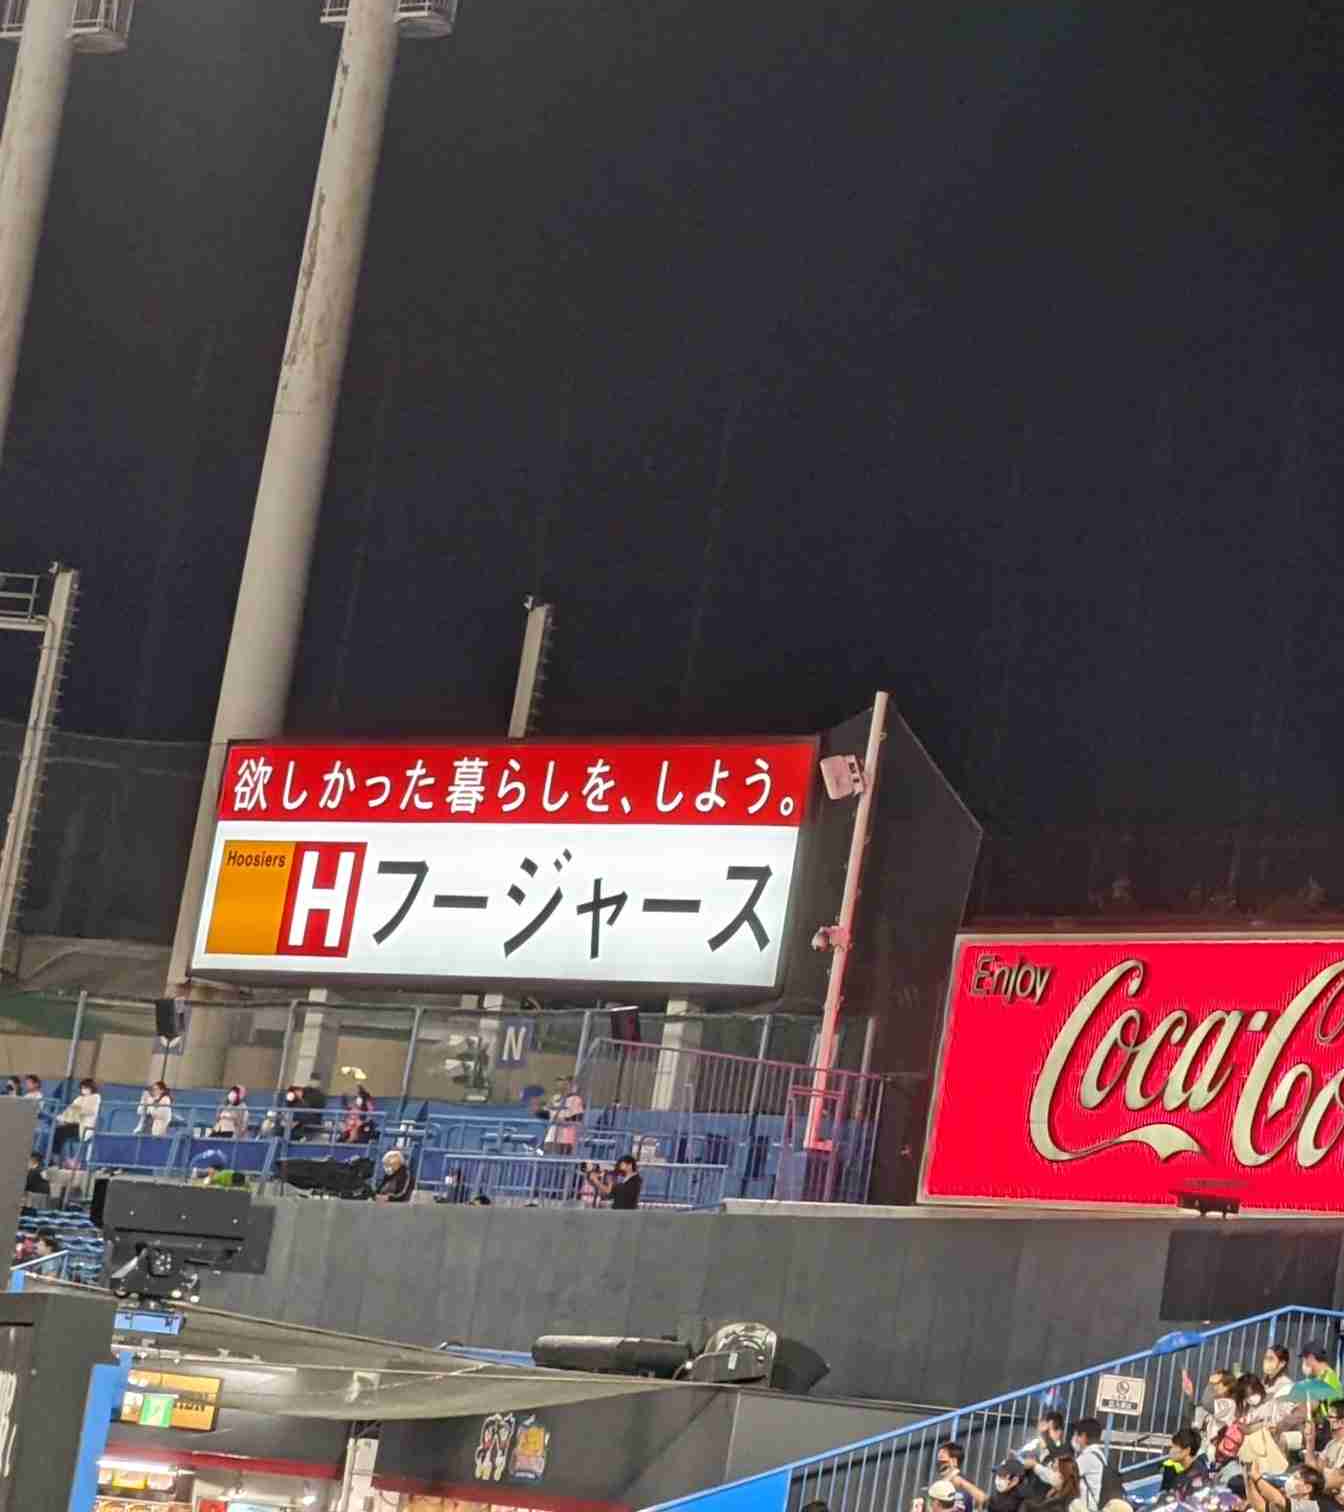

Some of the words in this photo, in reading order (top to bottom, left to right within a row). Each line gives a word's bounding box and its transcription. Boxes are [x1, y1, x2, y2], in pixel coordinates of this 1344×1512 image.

[233, 758, 796, 816] 欲しかった暮らしを、しよう。
[227, 851, 286, 868] Hoosiers
[289, 852, 355, 947] H
[373, 850, 773, 959] フージャース
[971, 955, 1053, 1005] Enjoy
